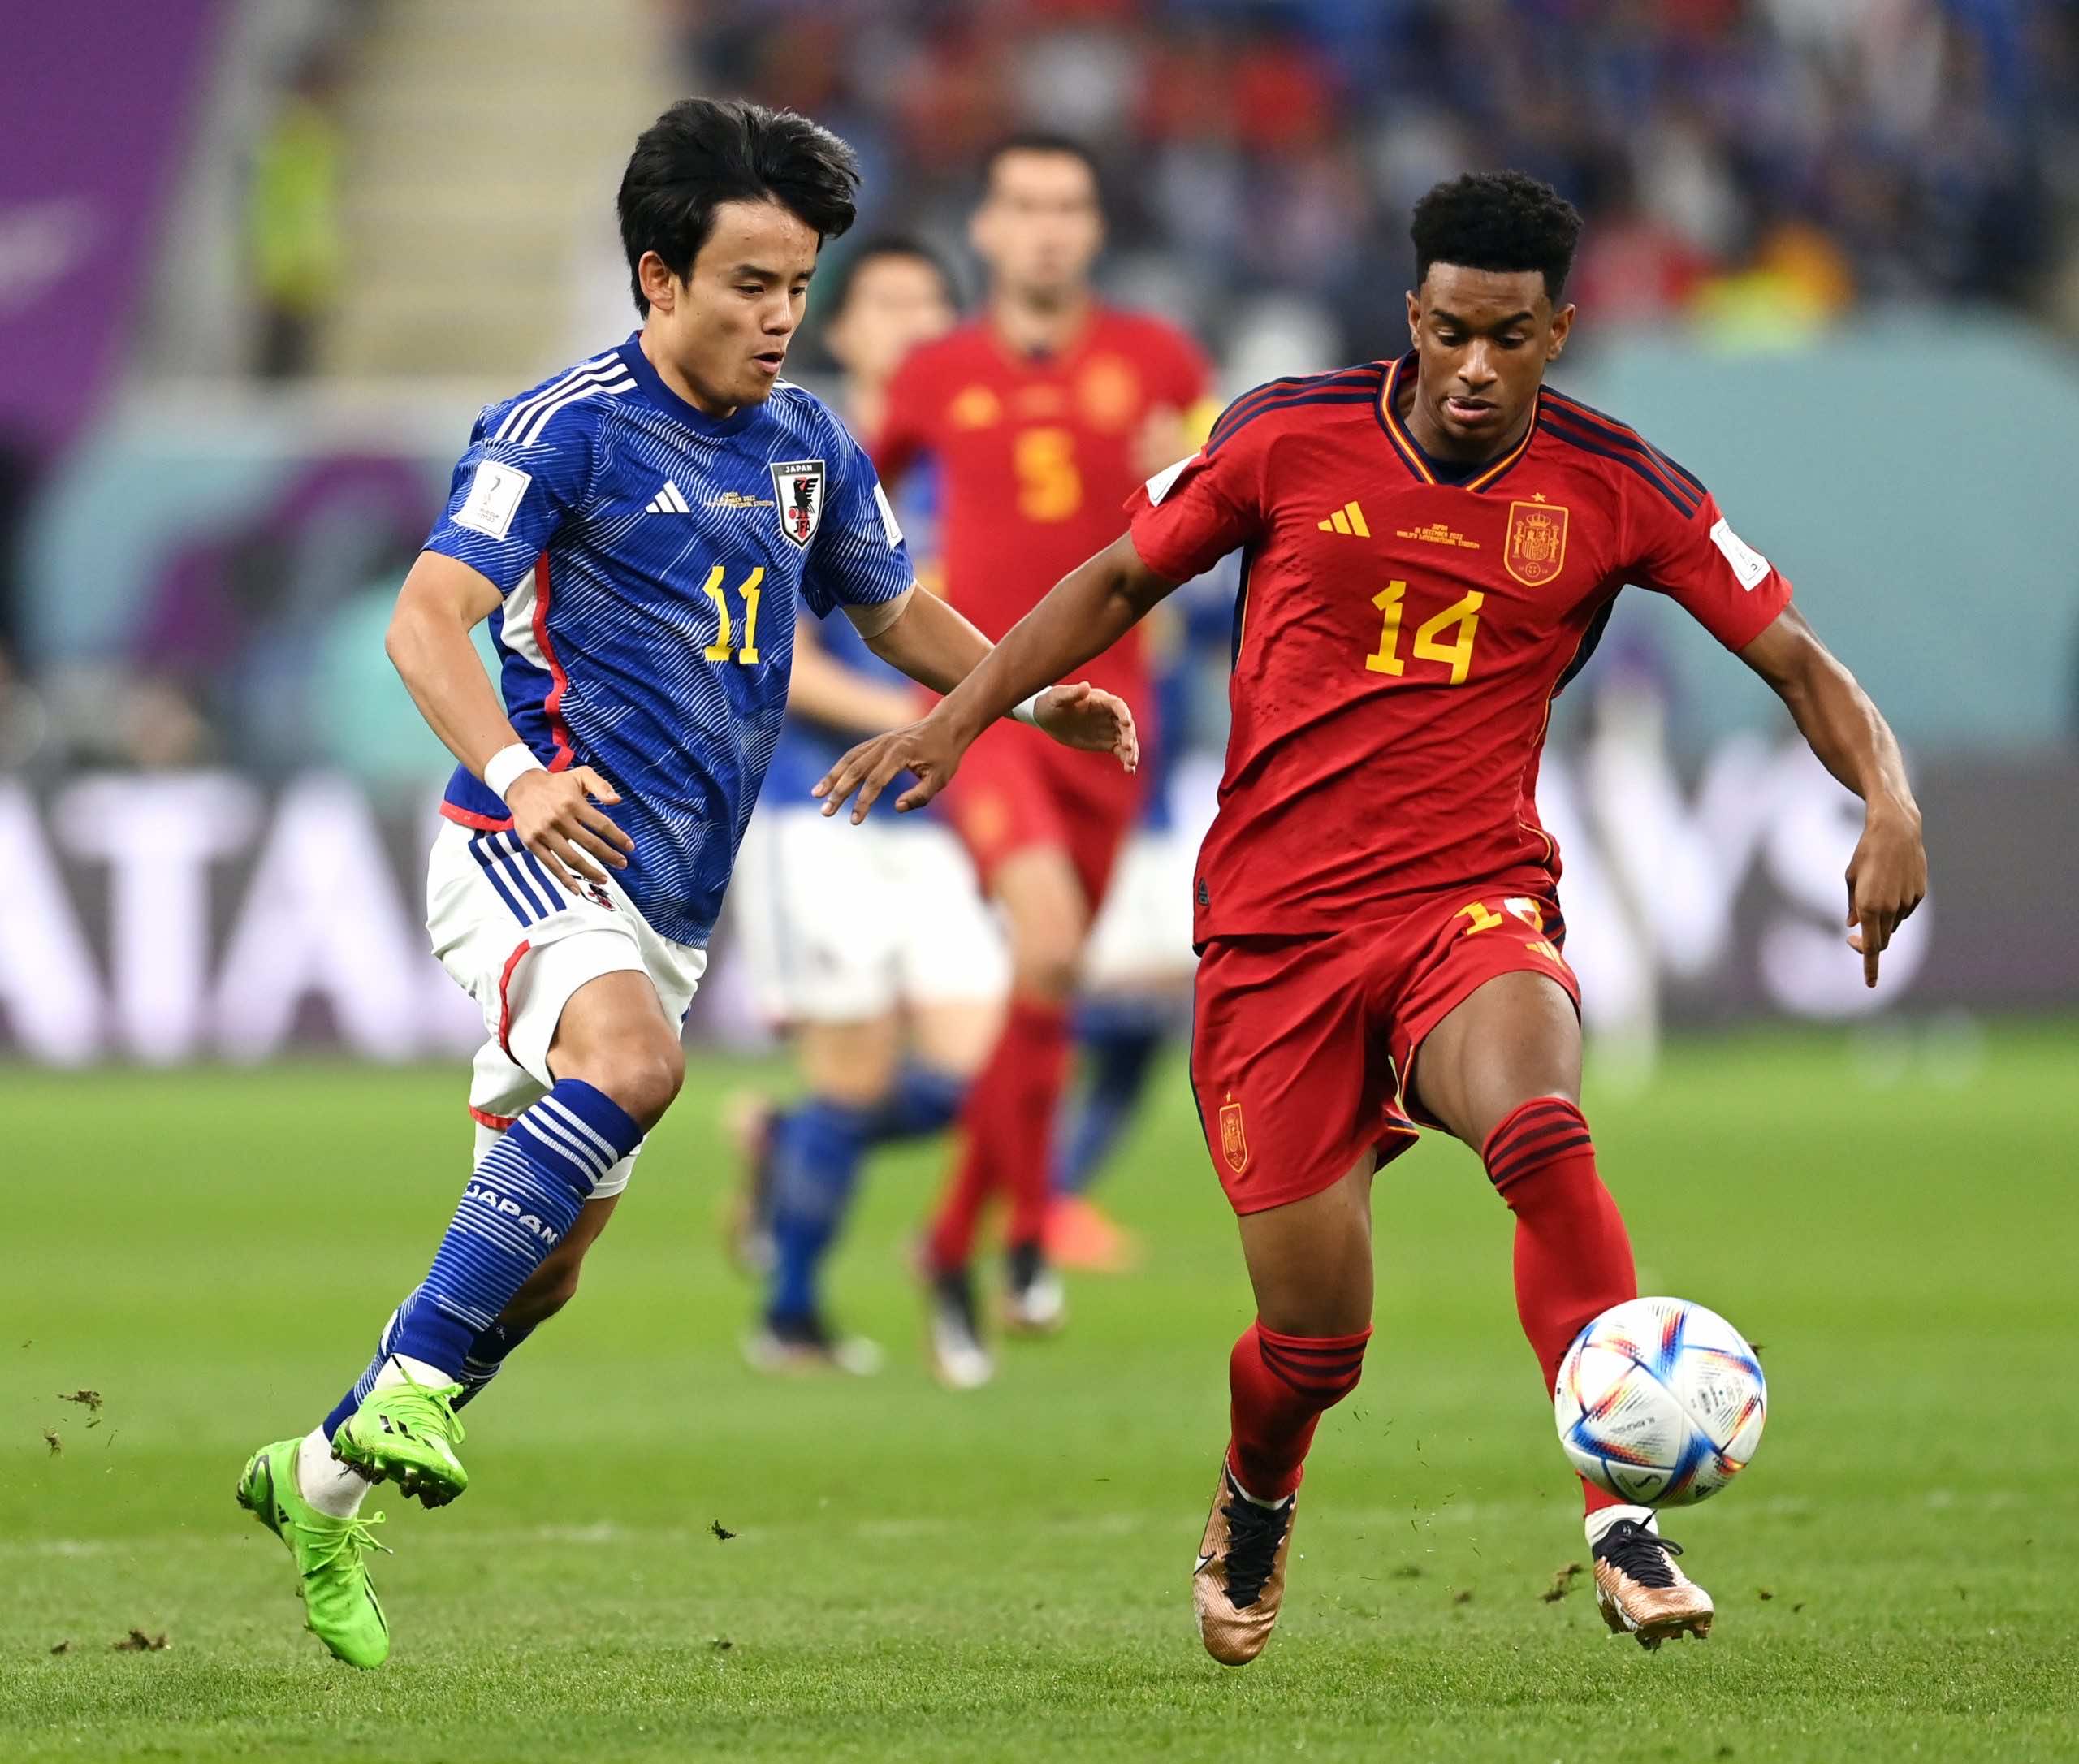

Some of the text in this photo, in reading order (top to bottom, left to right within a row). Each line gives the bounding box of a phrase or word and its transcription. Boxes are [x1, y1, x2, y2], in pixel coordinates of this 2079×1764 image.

[785, 464, 813, 473] JAPAN
[1015, 426, 1083, 525] 5
[793, 520, 811, 534] JFA
[702, 565, 765, 664] 11
[1365, 579, 1485, 685] 14
[465, 1184, 560, 1245] JAPAN
